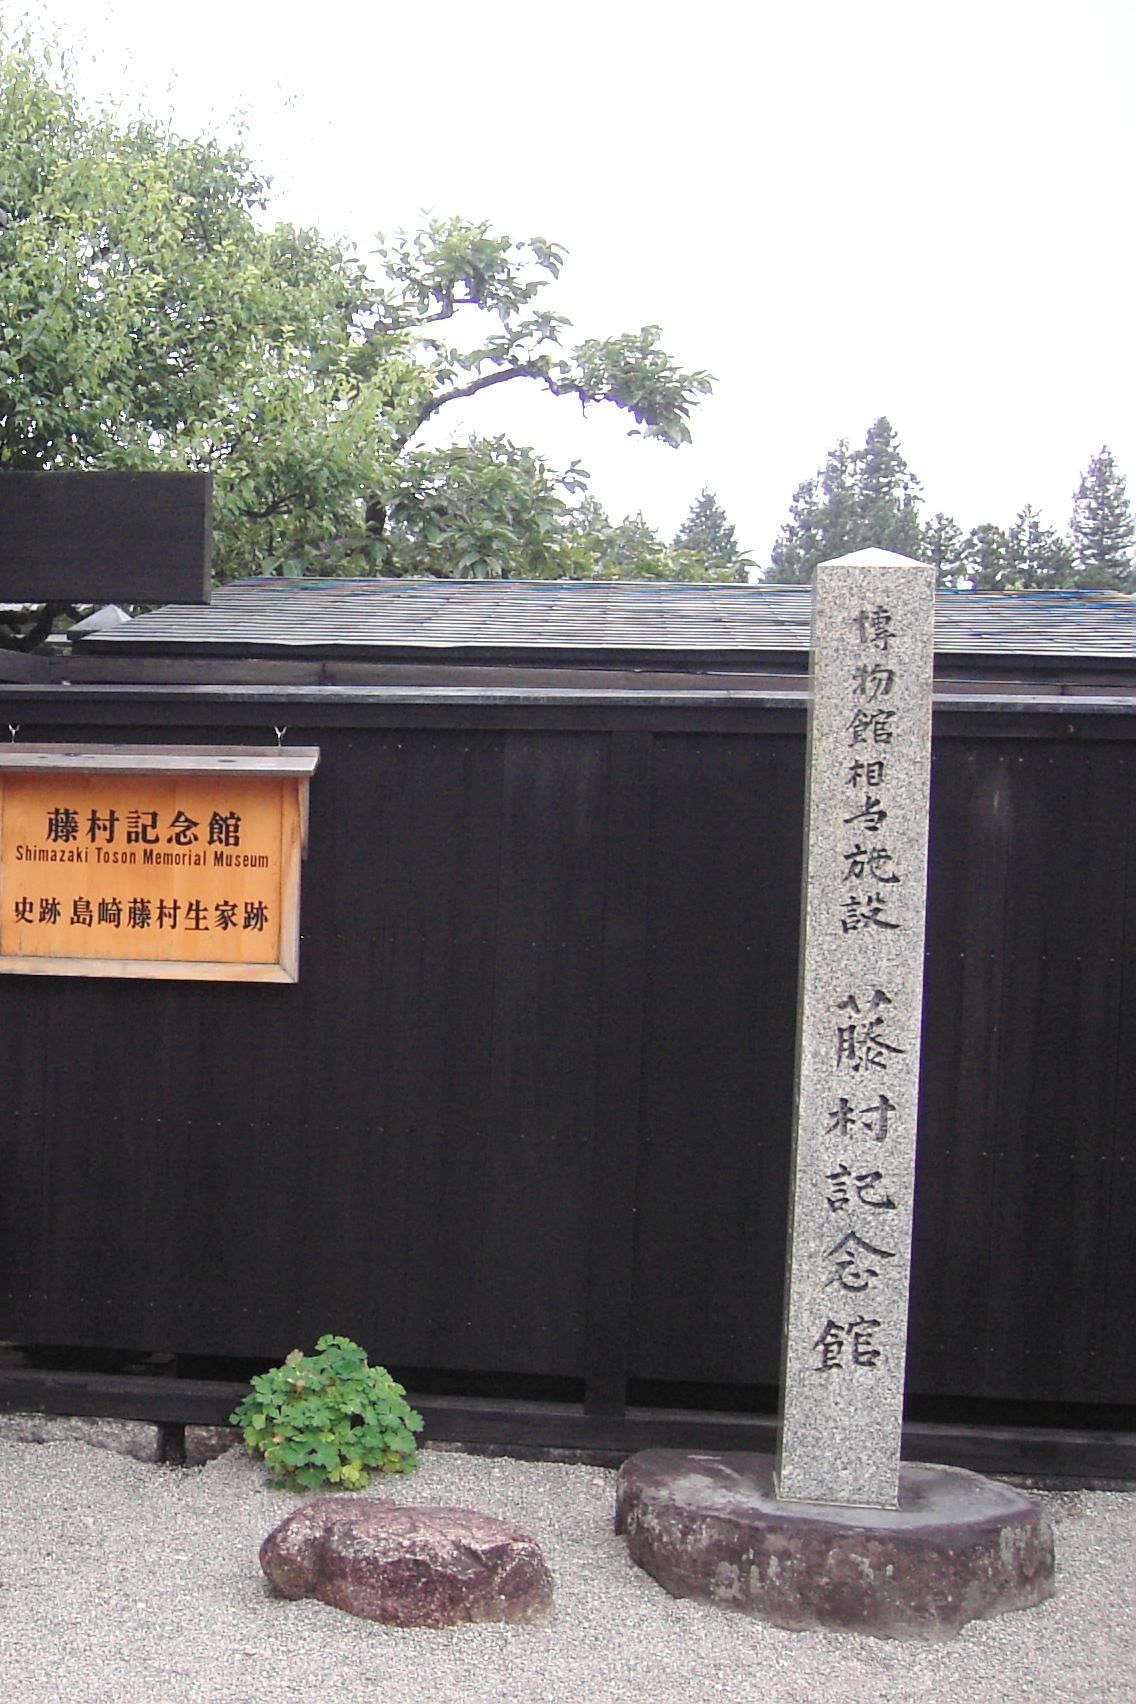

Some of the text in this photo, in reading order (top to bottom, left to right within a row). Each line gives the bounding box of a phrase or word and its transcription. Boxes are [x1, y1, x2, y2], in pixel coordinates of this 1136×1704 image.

[46, 807, 243, 847] 藤村記念館
[15, 845, 269, 868] Shimazaki Toson Memorial Museum
[812, 989, 906, 1372] 藤村記念館
